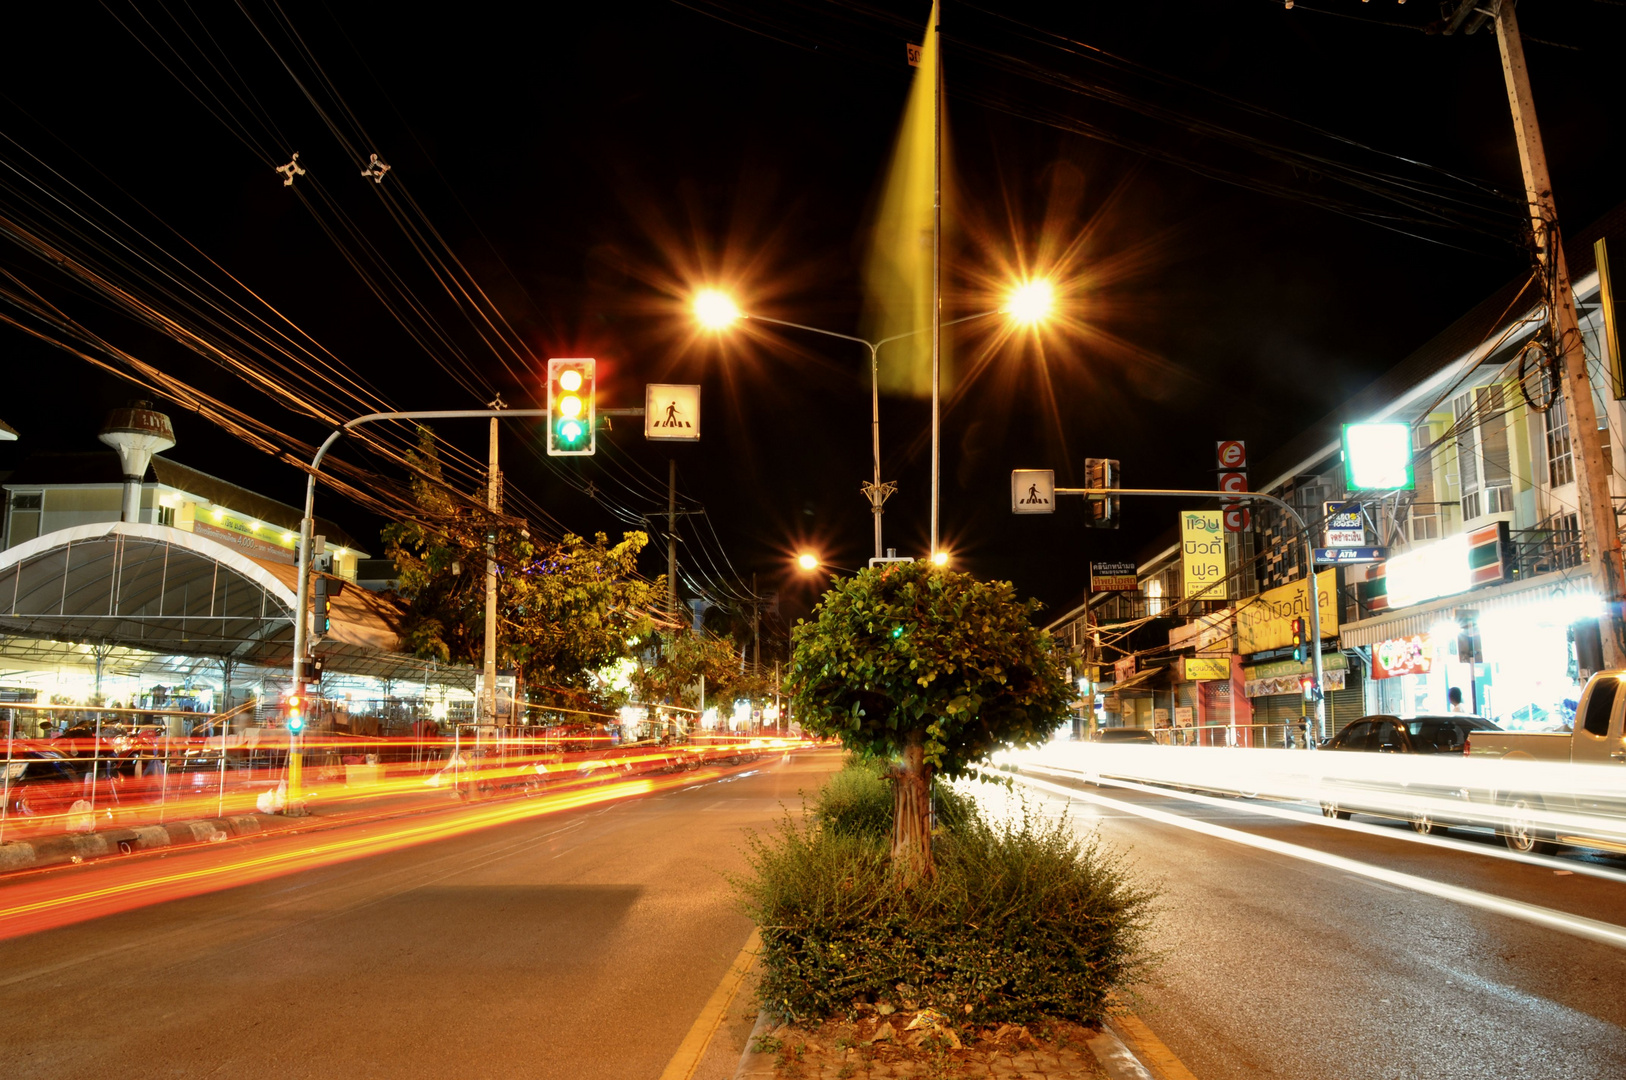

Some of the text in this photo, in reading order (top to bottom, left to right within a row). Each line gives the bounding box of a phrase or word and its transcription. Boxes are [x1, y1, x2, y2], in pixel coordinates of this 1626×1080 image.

[1187, 515, 1220, 530] แว่น
[1185, 536, 1223, 555] บิวตี้
[1338, 551, 1358, 559] ATM
[1192, 563, 1219, 581] ฟูล
